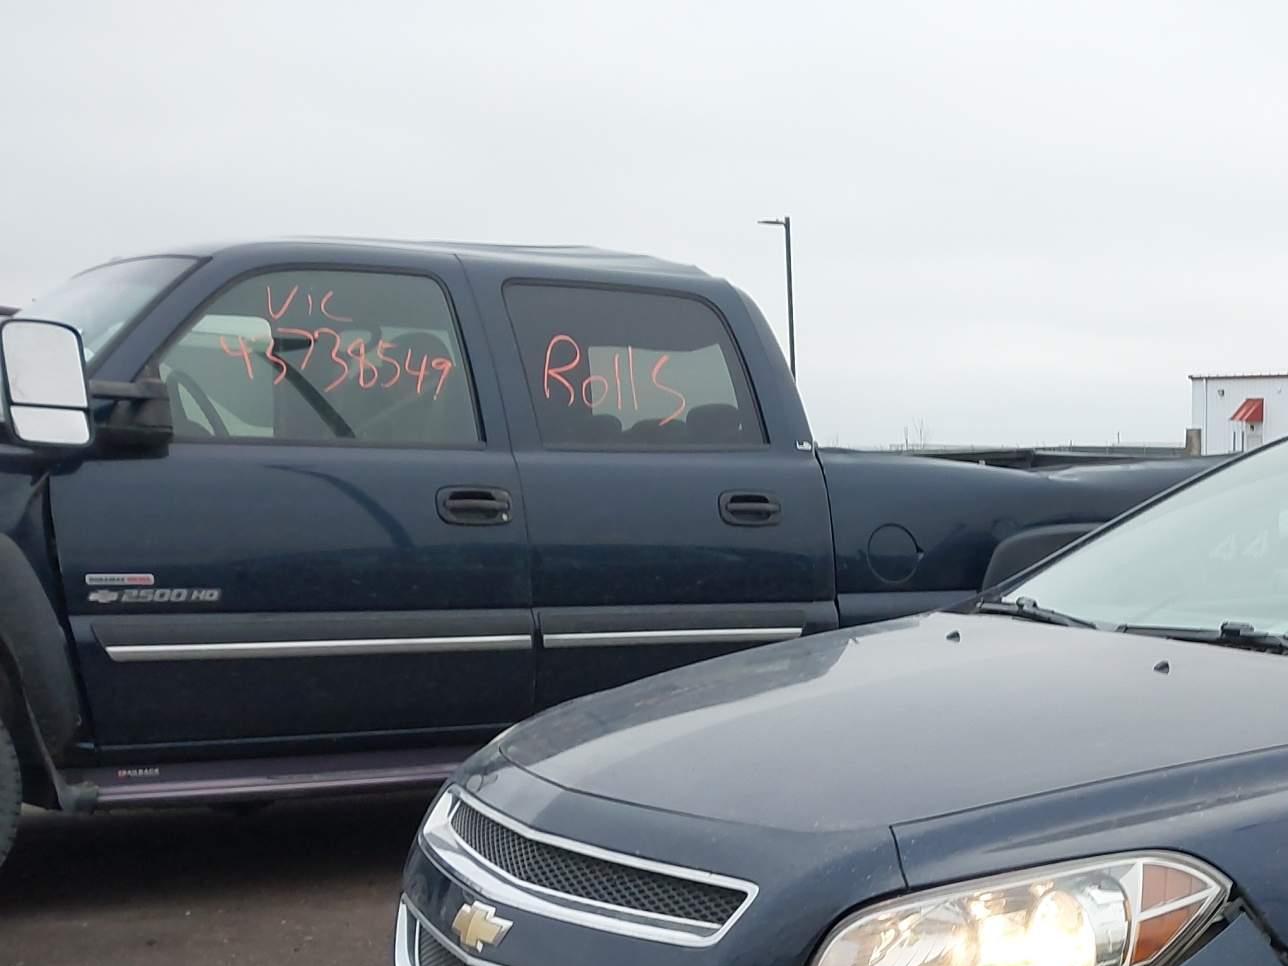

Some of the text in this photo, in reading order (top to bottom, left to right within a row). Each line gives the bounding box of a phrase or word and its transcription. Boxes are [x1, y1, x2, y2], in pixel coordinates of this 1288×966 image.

[220, 328, 455, 400] 43738549
[121, 588, 221, 602] 2500 HD
